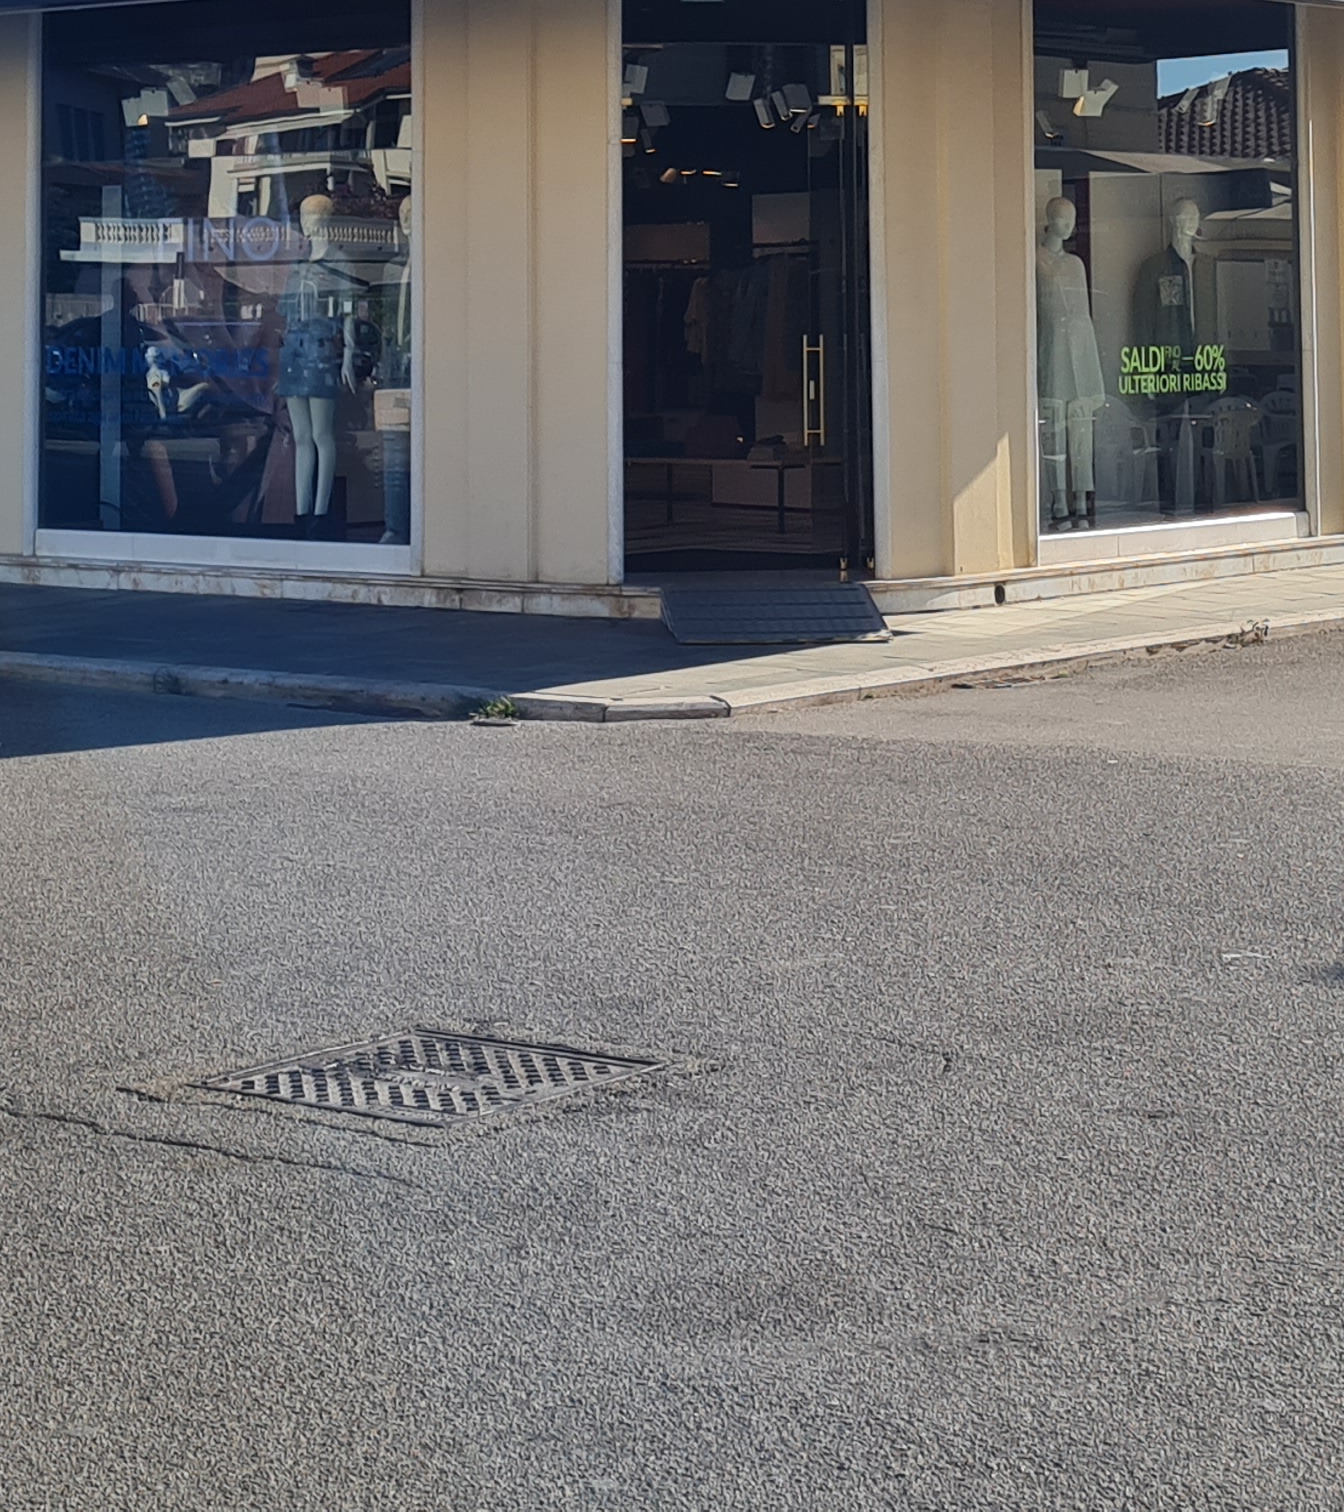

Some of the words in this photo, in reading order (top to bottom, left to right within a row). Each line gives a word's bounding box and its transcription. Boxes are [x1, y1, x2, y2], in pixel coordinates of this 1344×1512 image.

[1120, 346, 1165, 373] SALDI
[1118, 374, 1181, 395] ULTERIORI
[1183, 372, 1227, 392] RIBASSI
